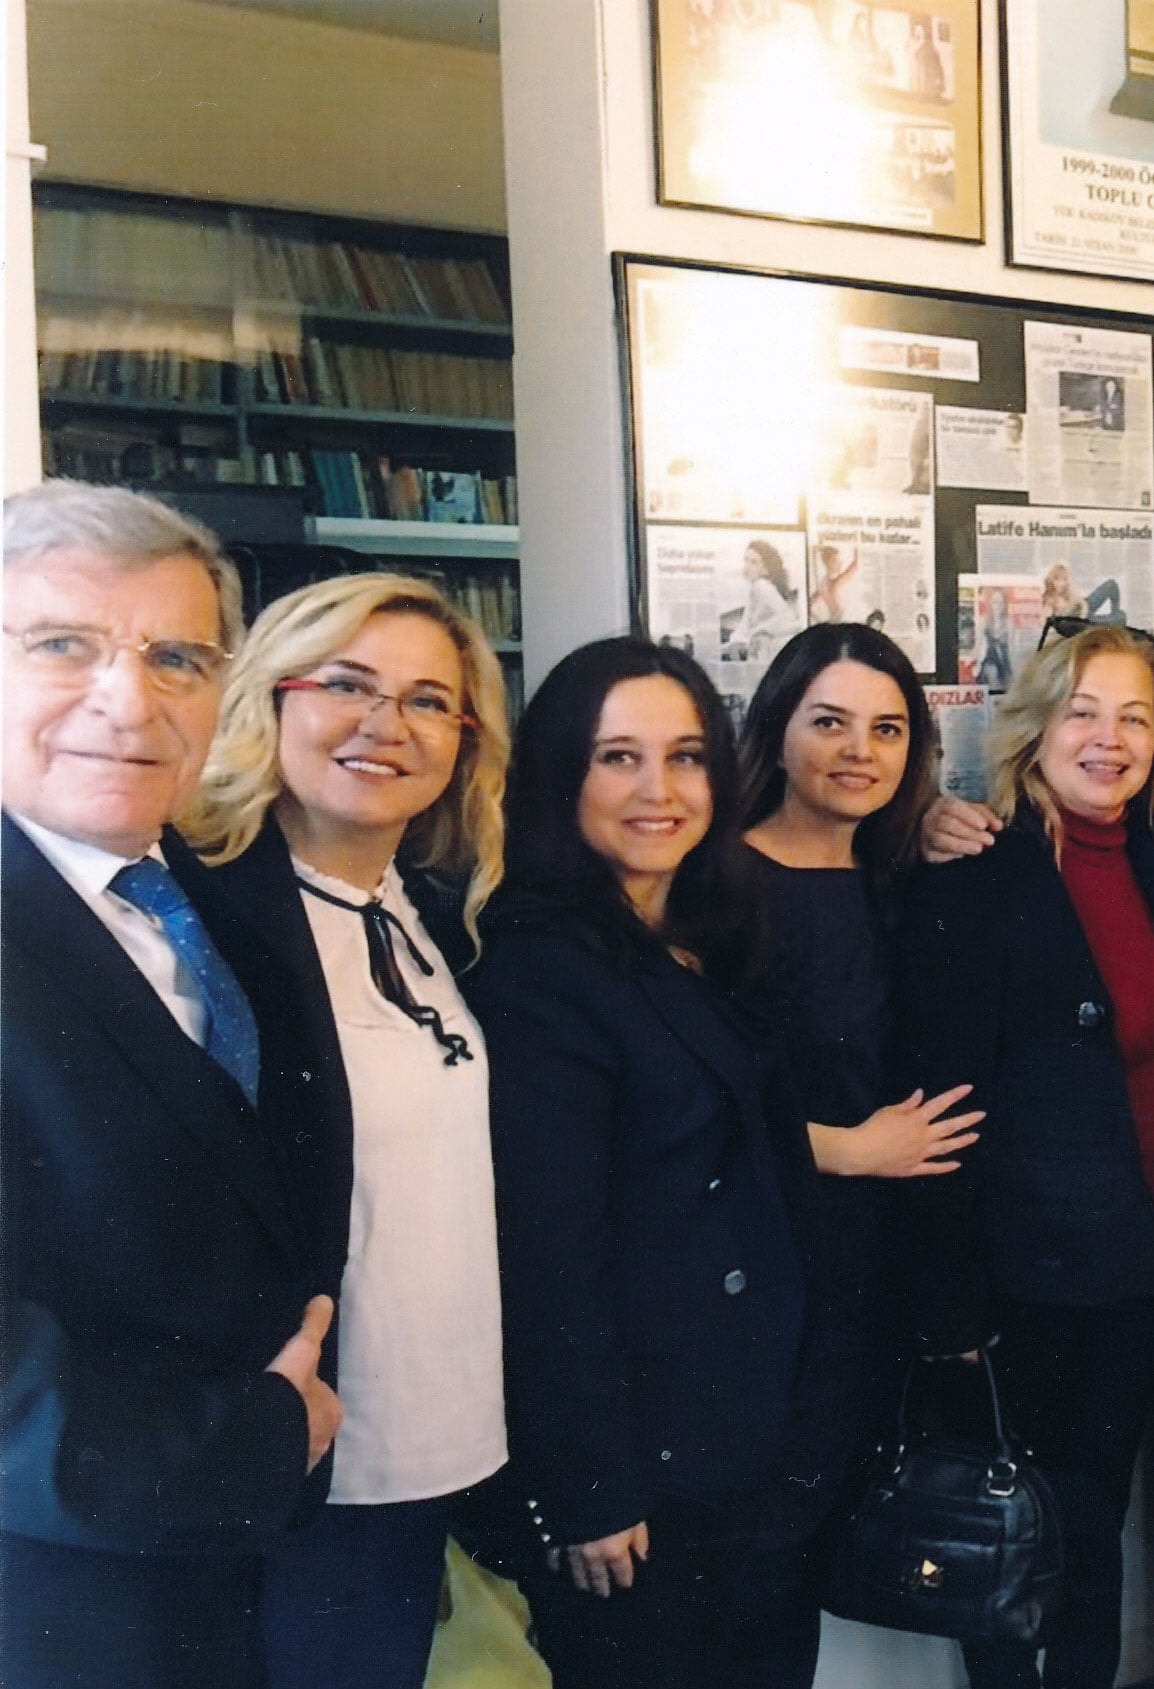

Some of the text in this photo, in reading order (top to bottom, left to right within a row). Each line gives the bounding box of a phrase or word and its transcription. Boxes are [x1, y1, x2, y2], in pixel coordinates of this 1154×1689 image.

[1061, 156, 1135, 181] 1999-2000
[1086, 184, 1143, 207] TOPLU
[978, 520, 1024, 537] Latife
[1099, 523, 1153, 541] başladı
